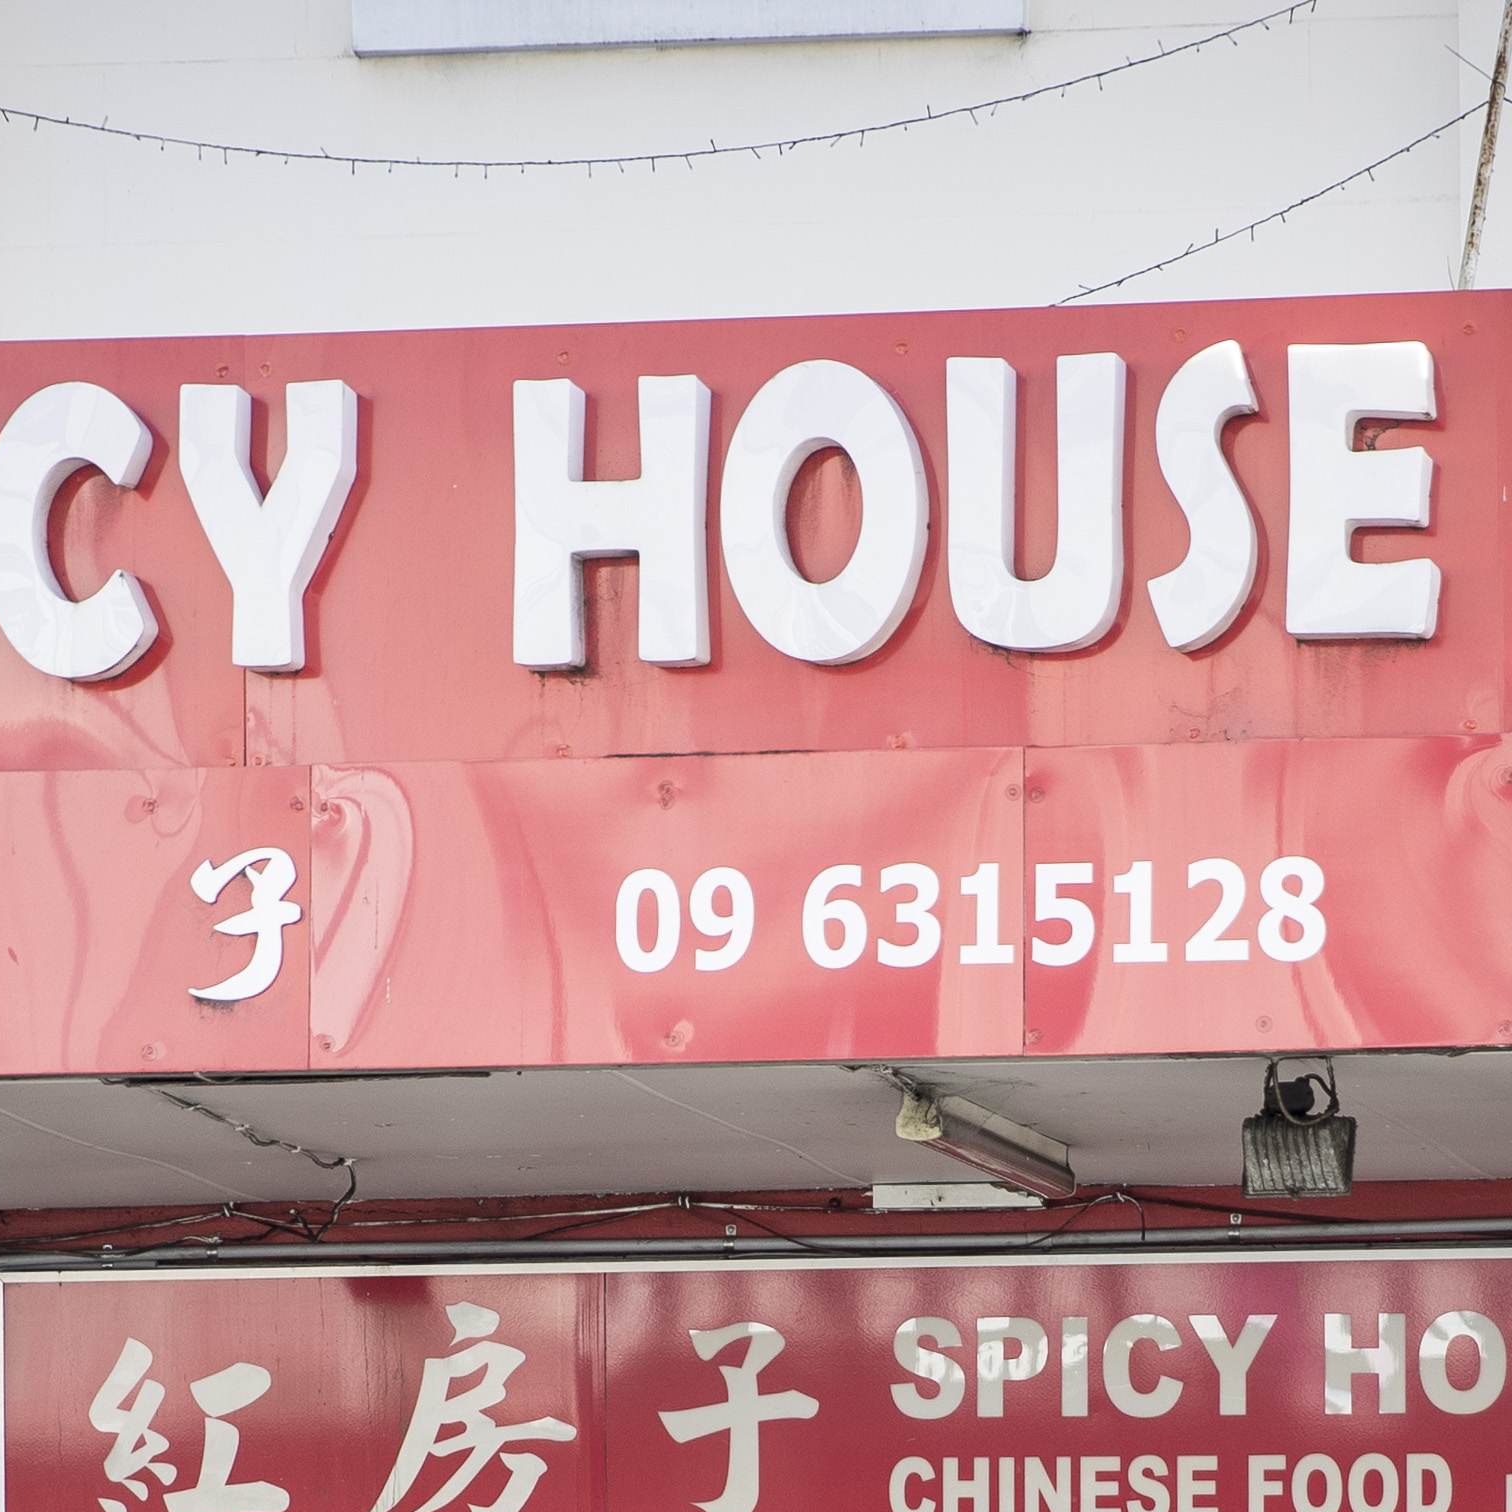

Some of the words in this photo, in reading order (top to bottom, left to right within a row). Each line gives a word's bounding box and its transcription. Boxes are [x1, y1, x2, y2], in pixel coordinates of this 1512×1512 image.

[512, 339, 1442, 673] HOUSE
[615, 865, 754, 973] 09
[800, 854, 1327, 970] 6315128
[888, 1312, 1278, 1421] SPICY
